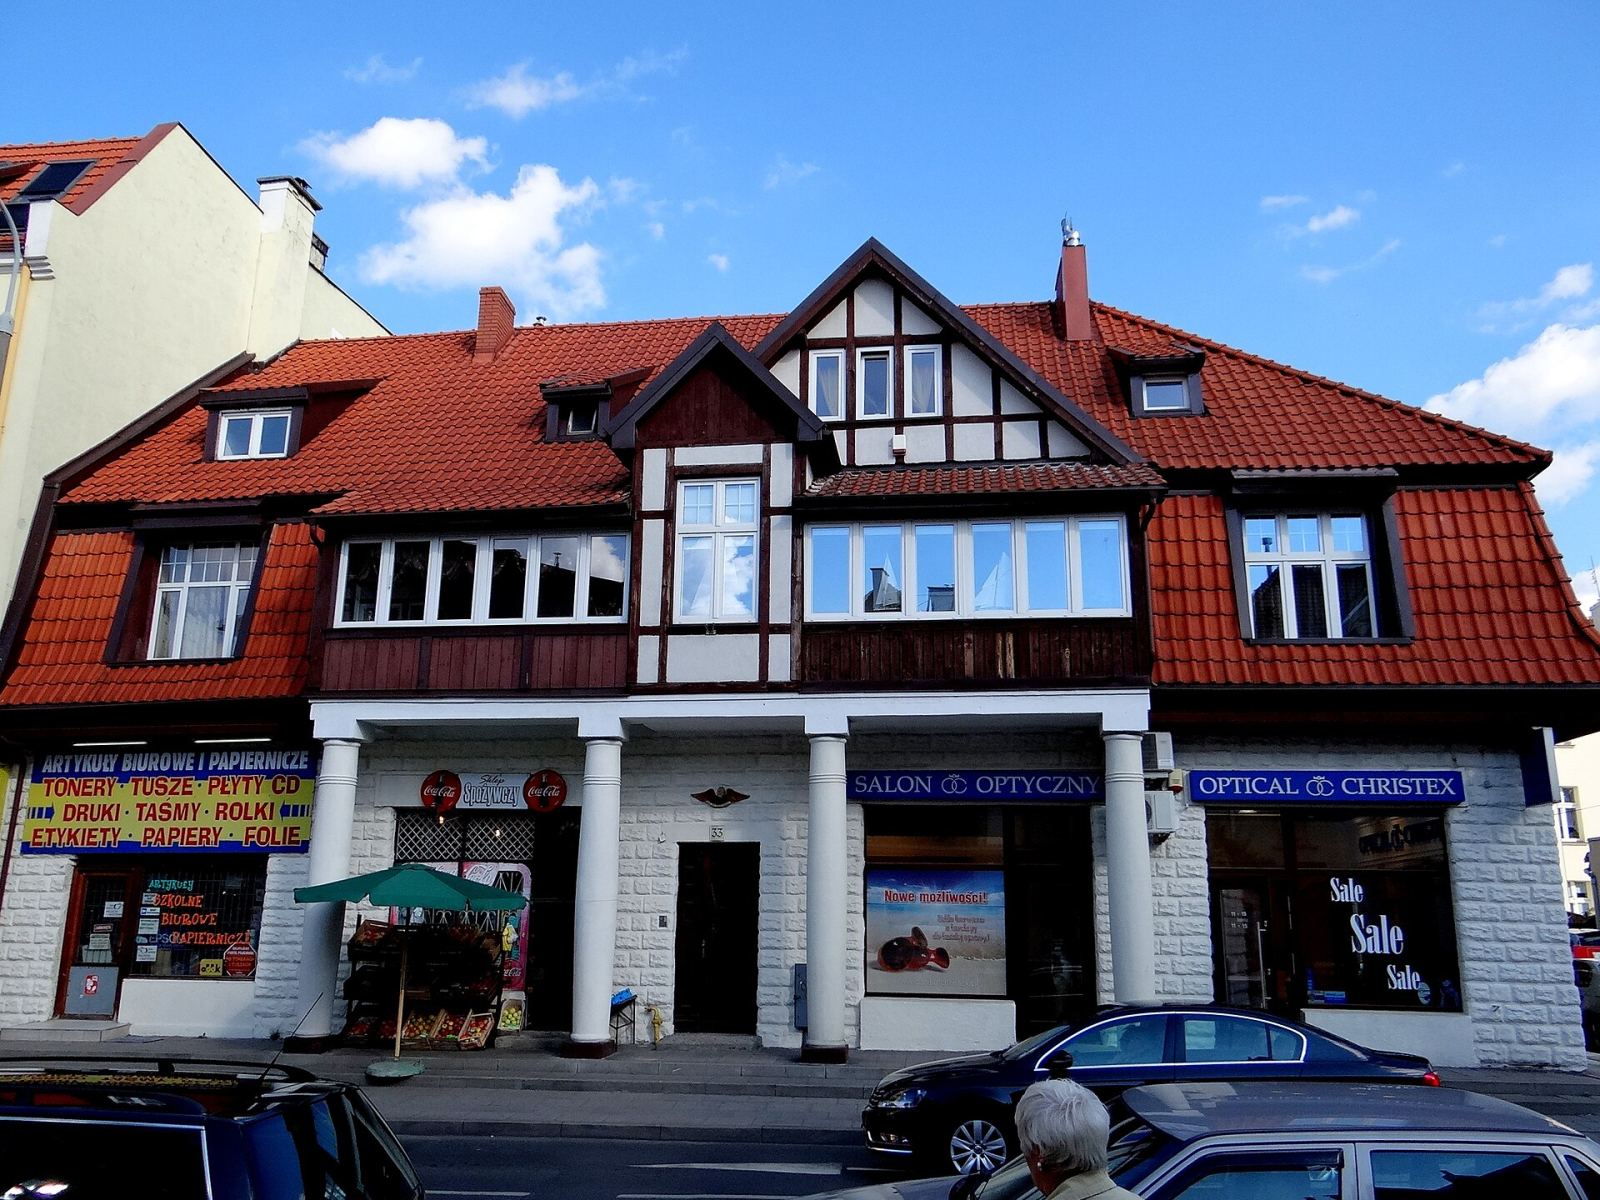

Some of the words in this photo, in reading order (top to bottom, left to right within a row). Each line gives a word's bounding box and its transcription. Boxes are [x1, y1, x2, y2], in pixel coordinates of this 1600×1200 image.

[42, 754, 118, 773] ARTYKUŁY
[121, 752, 195, 772] BIUROWE
[198, 752, 205, 771] I
[208, 750, 309, 770] PAPIERNICZE
[43, 777, 118, 797] TONERY
[131, 776, 195, 796] TUSZE
[207, 775, 266, 796] PŁYTY
[271, 774, 301, 796] CD
[479, 774, 505, 786] Sklep
[855, 775, 933, 793] SALON
[976, 775, 1100, 794] OPTYCZNY
[1199, 777, 1299, 795] OPTICAL
[1341, 777, 1456, 795] CHRISTEX
[423, 785, 457, 797] Coca-Cola
[463, 782, 520, 807] Spożywczy
[528, 785, 561, 798] Coca-Cola
[62, 803, 121, 822] DRUKI
[135, 797, 201, 822] TAŚMY
[214, 801, 275, 821] ROLKI
[30, 827, 122, 847] ETYKIETY
[141, 826, 223, 847] PAPIERY
[242, 826, 301, 846] FOLIE
[711, 827, 723, 838] 33
[884, 889, 915, 904] Nowe
[919, 889, 989, 905] możliwości!
[1330, 877, 1364, 903] Sale
[152, 894, 204, 908] SZKOLNE
[161, 913, 218, 926] BIUROWE
[1350, 913, 1404, 955] Sale
[1386, 964, 1422, 990] Sale
